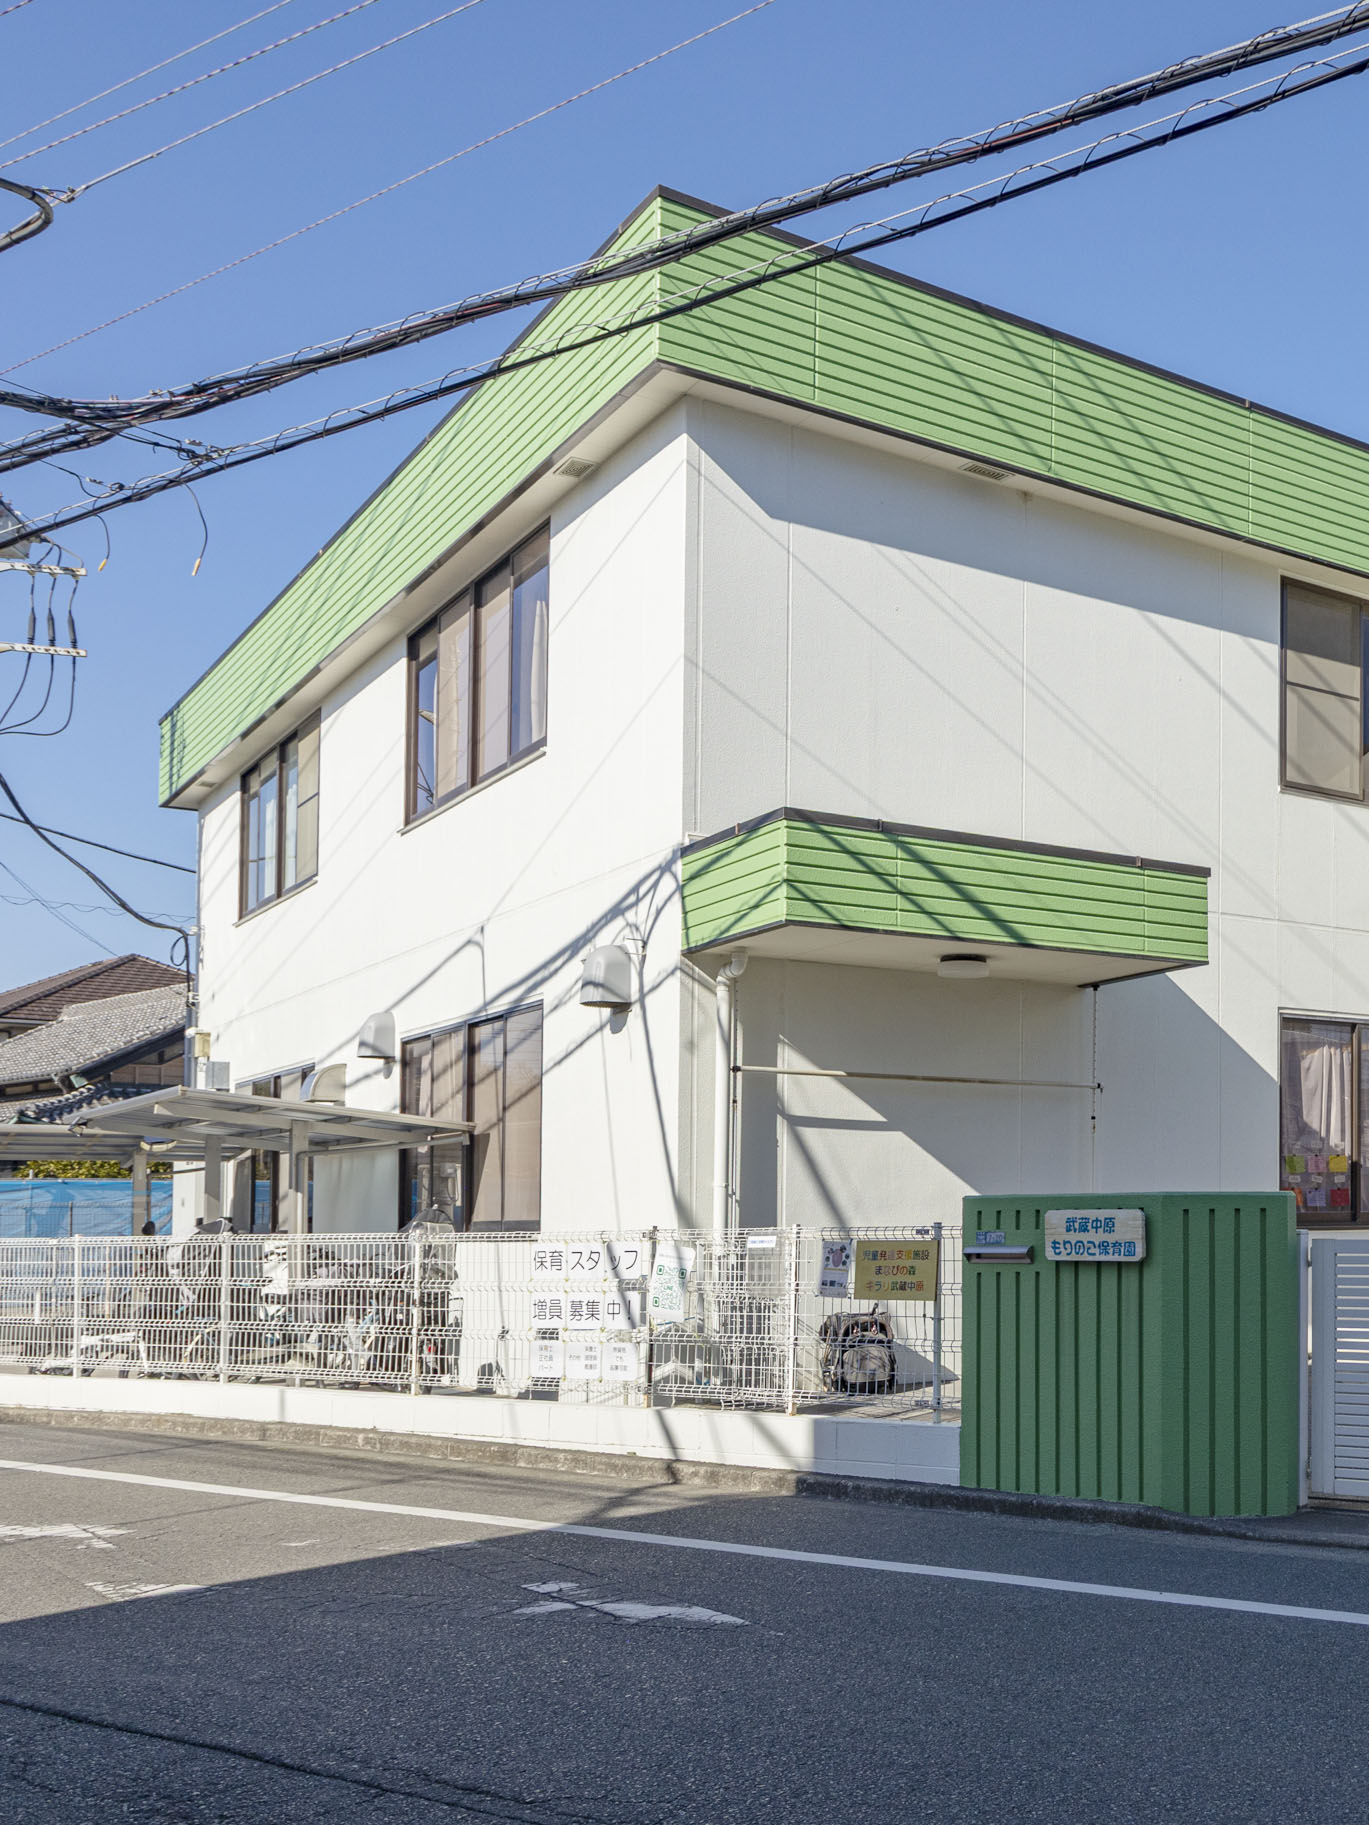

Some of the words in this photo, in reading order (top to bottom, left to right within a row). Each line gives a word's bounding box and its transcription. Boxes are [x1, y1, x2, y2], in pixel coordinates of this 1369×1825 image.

[1065, 1217, 1116, 1234] 武蔵中原
[1051, 1240, 1137, 1257] もりのこ保育園
[533, 1249, 638, 1272] 保育スタッフ
[875, 1265, 916, 1276] まなびの森
